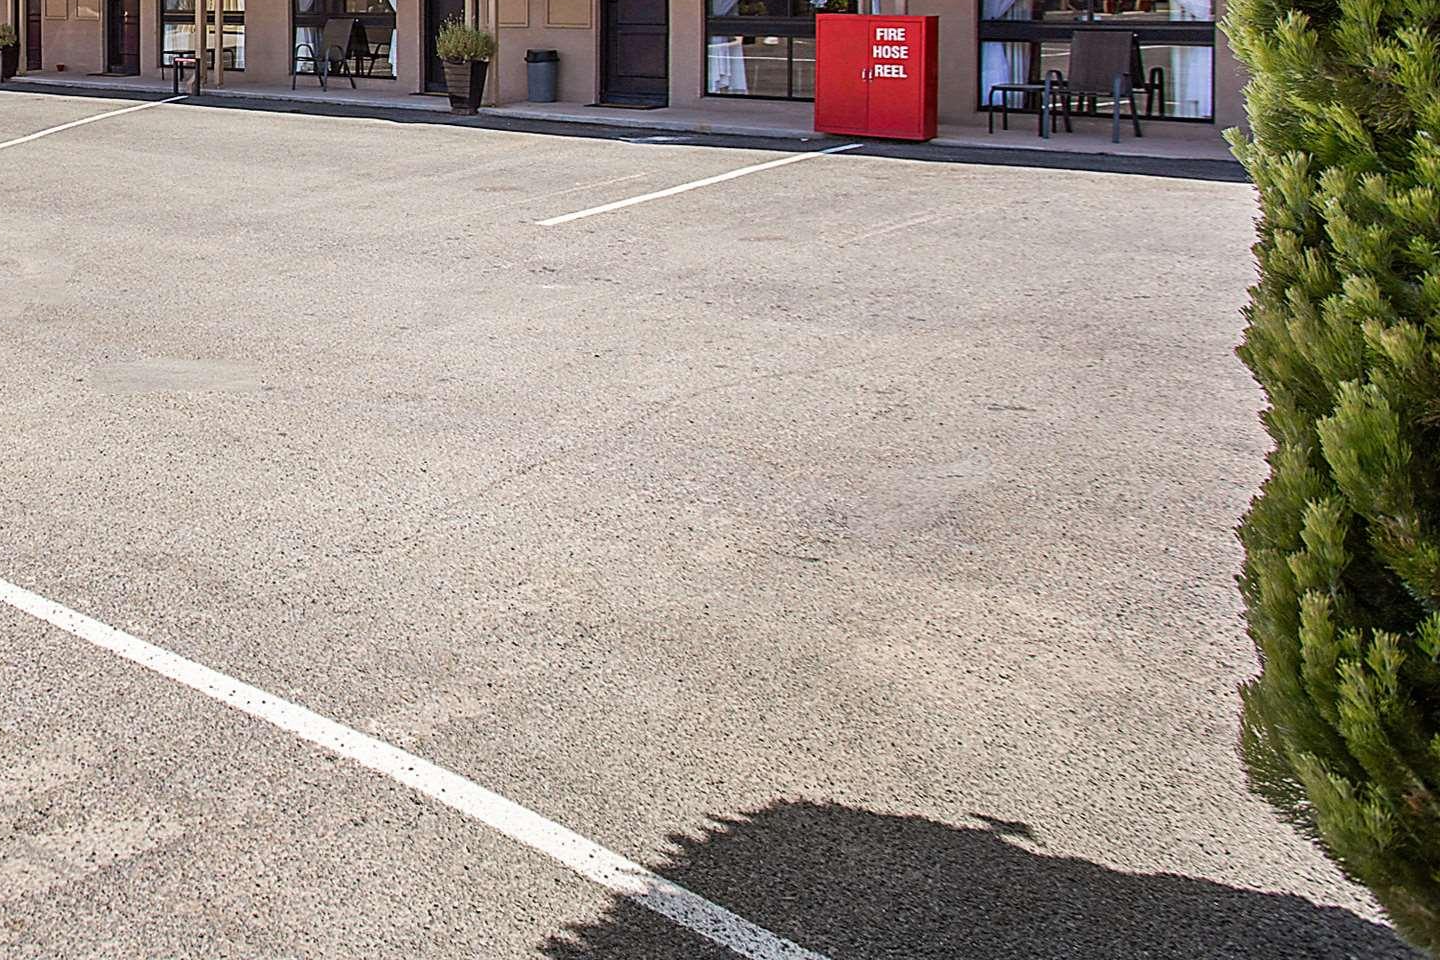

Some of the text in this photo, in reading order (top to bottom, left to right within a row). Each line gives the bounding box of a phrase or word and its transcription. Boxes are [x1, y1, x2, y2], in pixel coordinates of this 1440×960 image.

[875, 27, 906, 41] FIRE
[872, 44, 909, 59] HOSE
[874, 64, 908, 78] REEL
